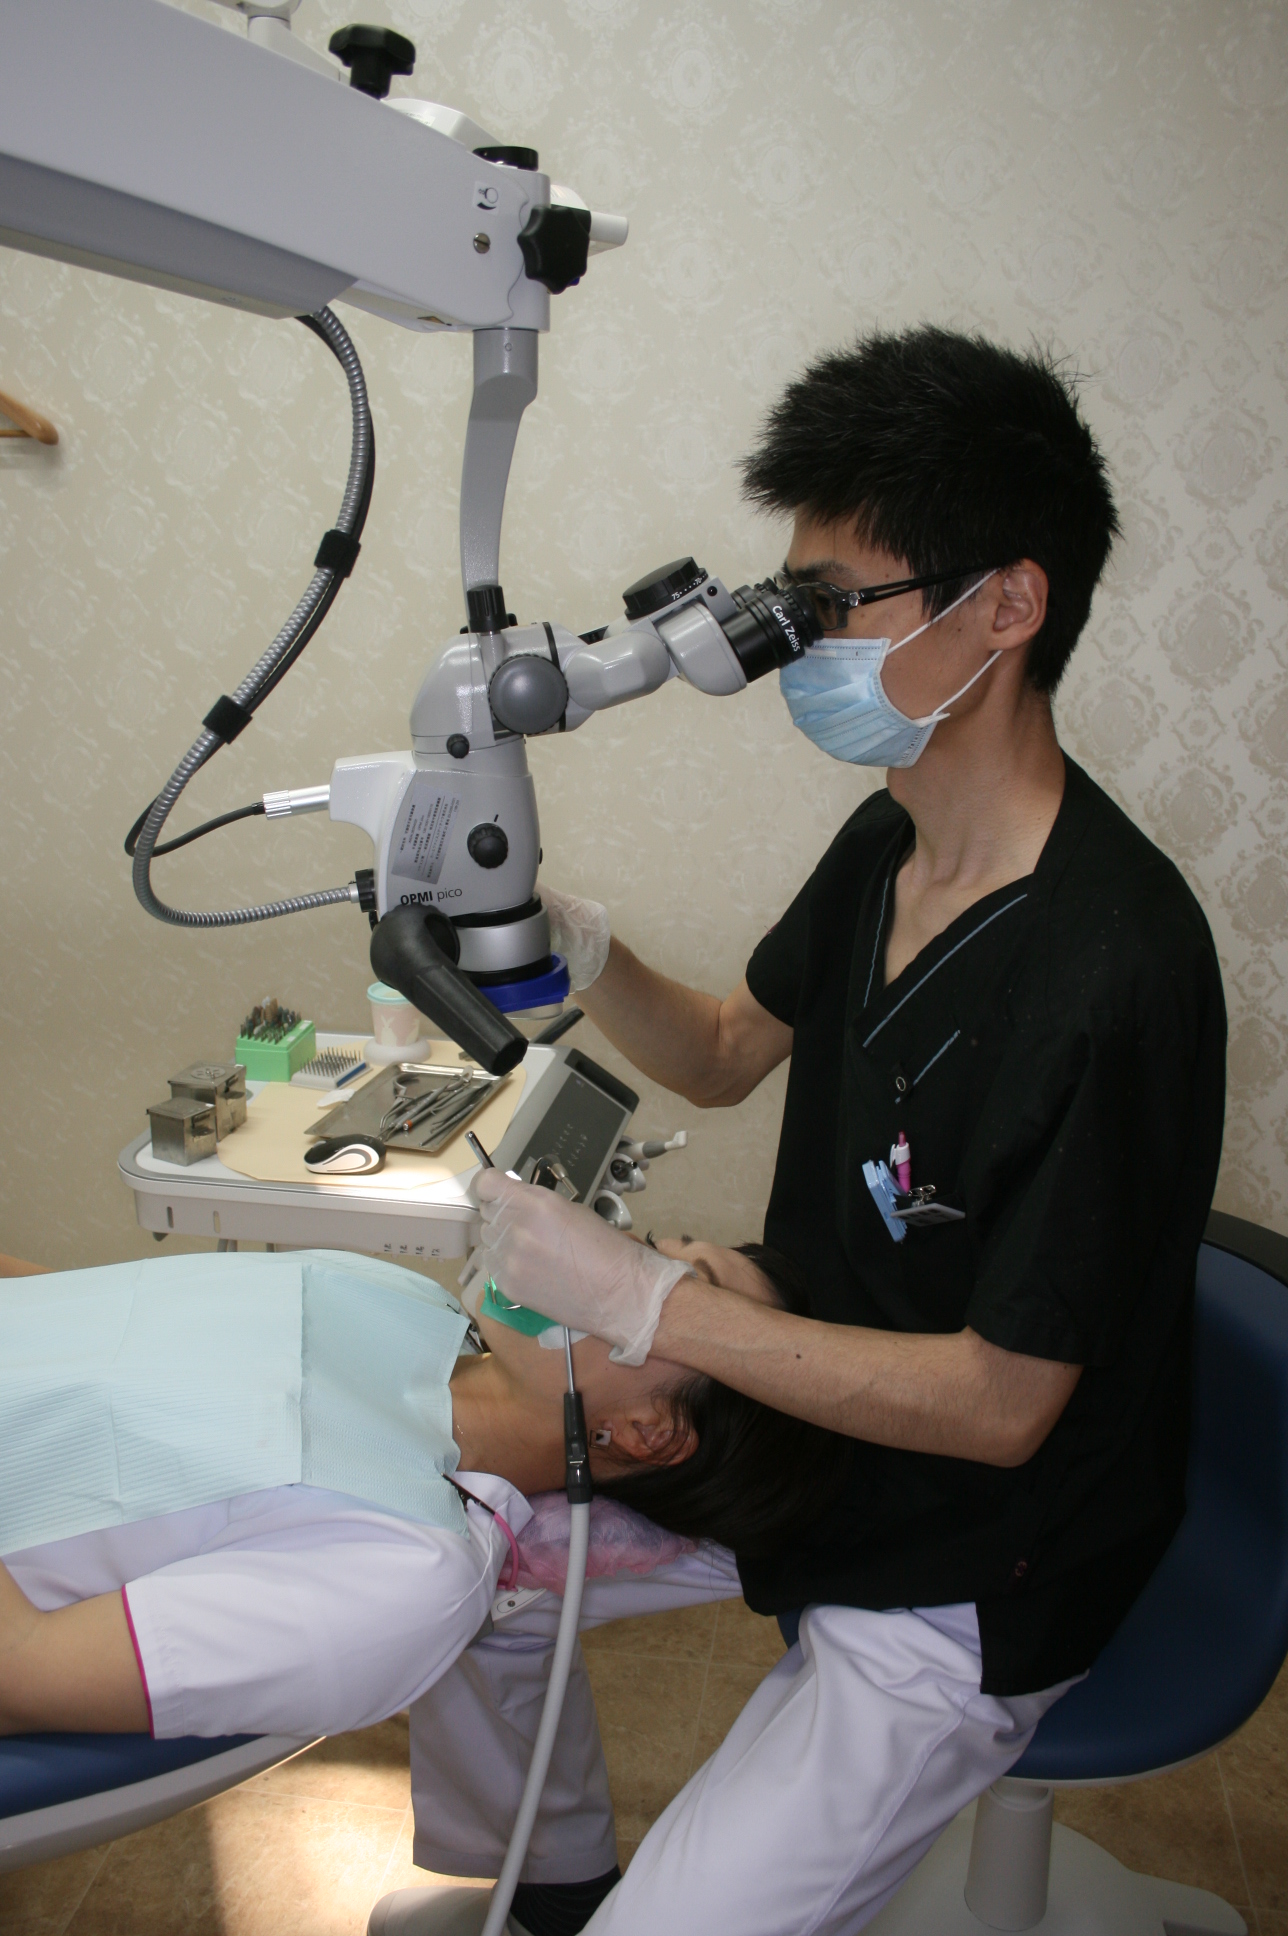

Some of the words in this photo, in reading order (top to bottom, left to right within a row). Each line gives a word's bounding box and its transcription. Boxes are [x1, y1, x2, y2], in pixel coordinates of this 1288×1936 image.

[772, 605, 791, 626] Carl
[784, 626, 801, 652] Zeiss
[400, 891, 433, 905] OPMI
[437, 888, 463, 902] pico
